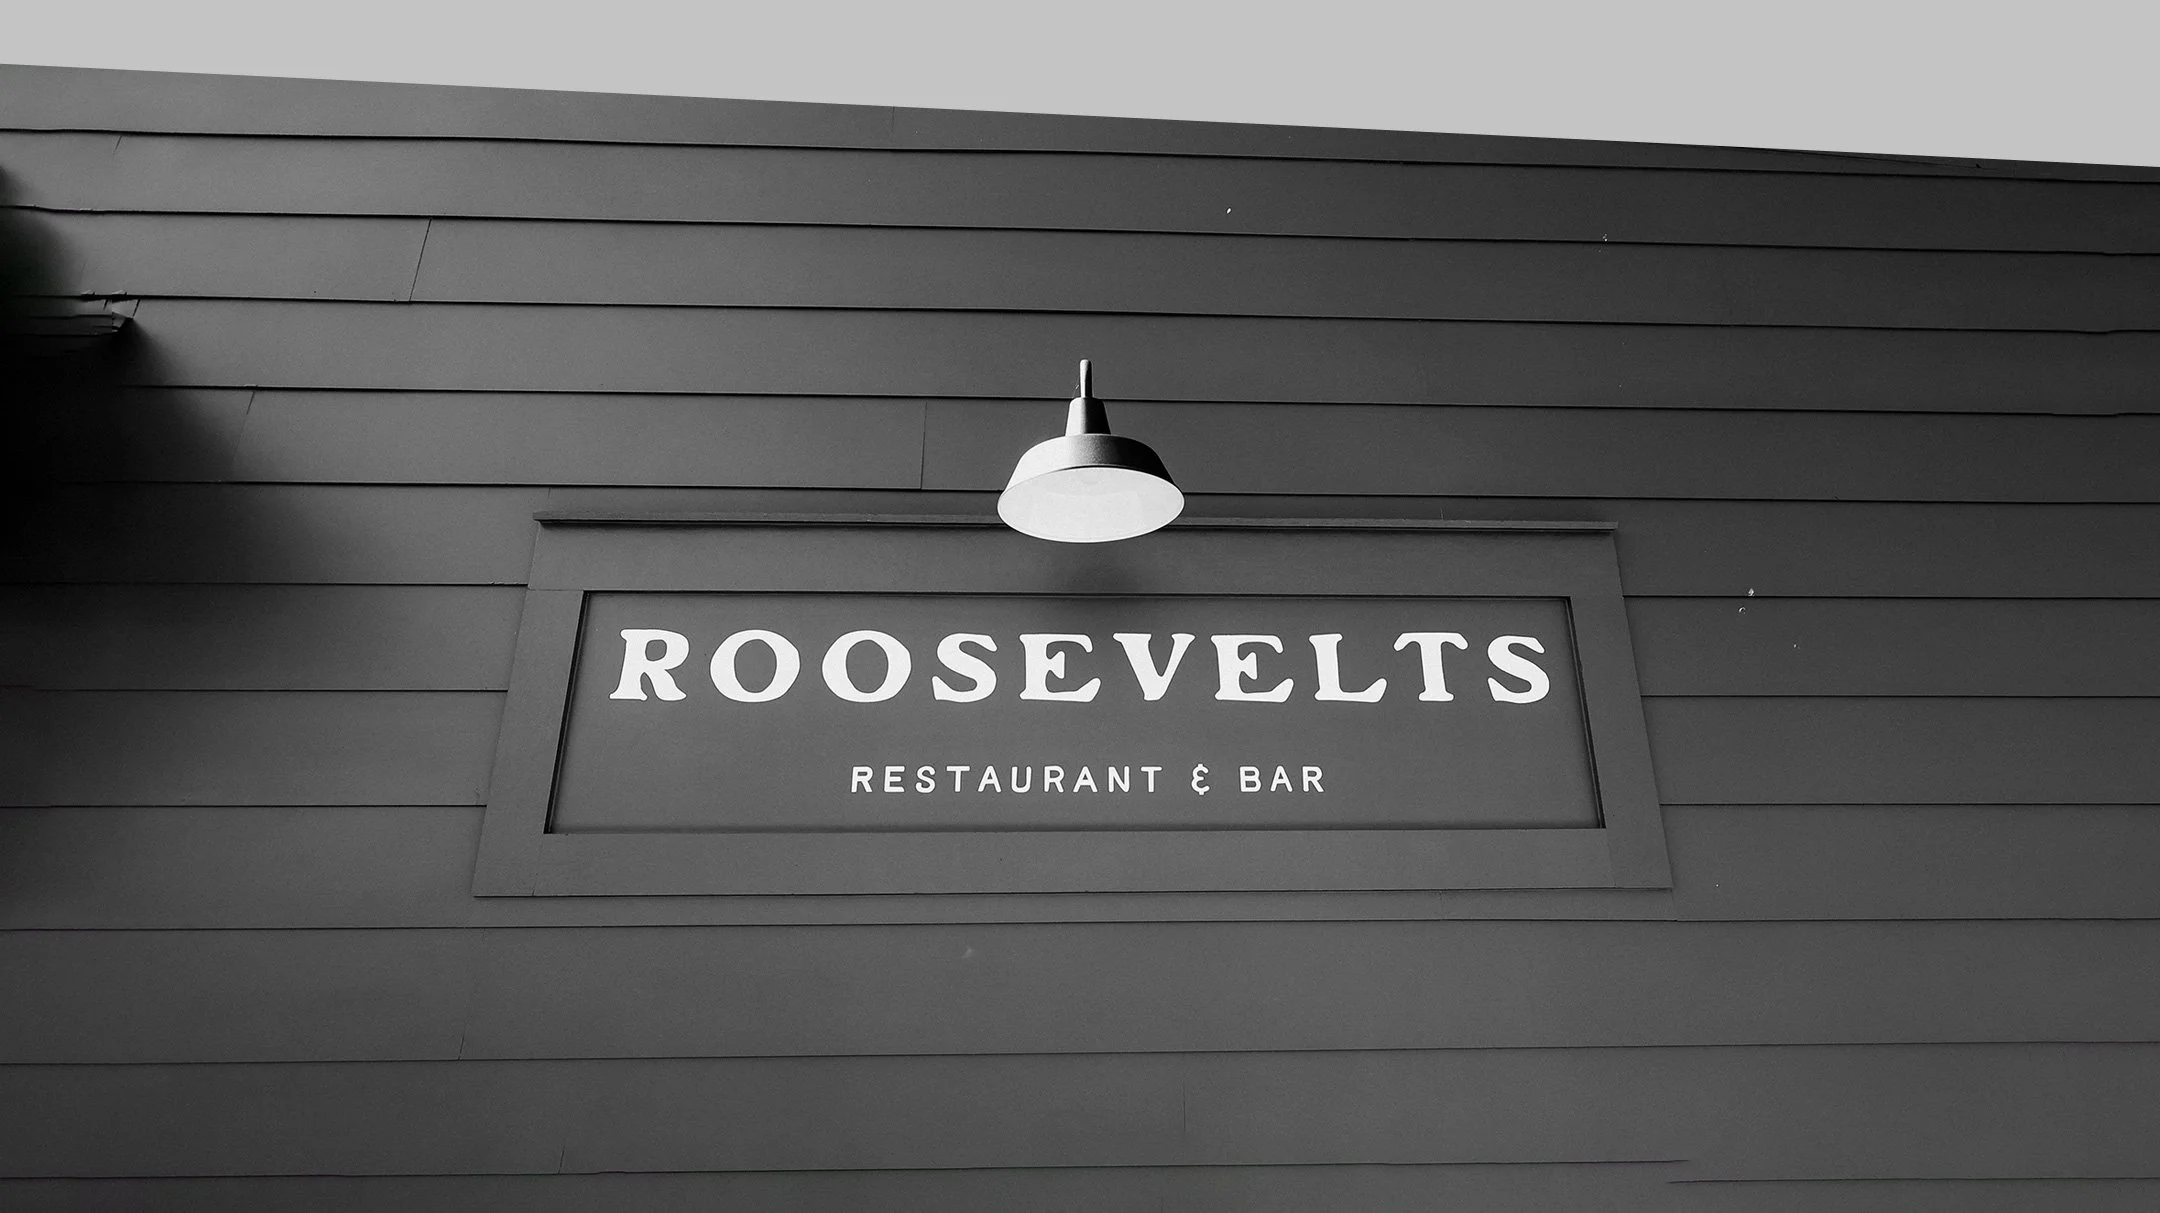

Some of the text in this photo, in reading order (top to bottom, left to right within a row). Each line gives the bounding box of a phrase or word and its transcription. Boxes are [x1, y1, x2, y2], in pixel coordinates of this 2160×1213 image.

[609, 628, 1551, 704] ROOSEVELTS
[850, 763, 1325, 796] RESTAURANT & BAR
